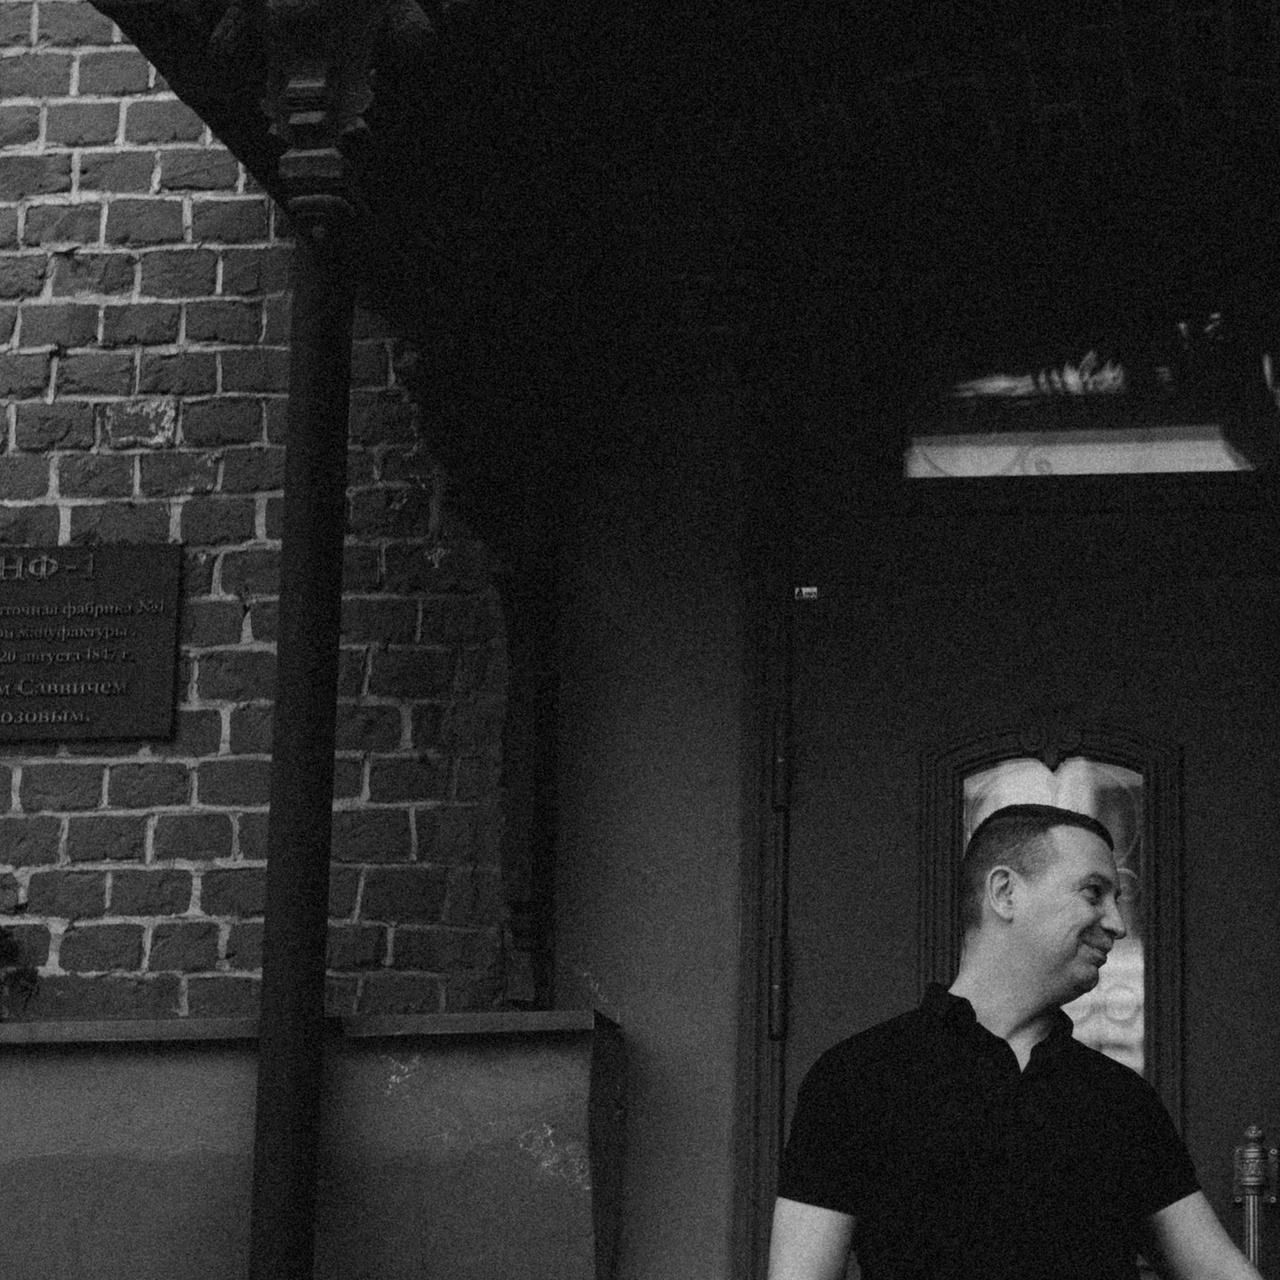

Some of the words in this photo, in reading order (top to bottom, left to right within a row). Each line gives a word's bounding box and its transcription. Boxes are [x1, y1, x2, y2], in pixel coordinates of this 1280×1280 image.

[0, 604, 58, 616] точная
[62, 600, 132, 619] фабрика
[20, 651, 81, 665] августа
[16, 678, 127, 696] Саввичем
